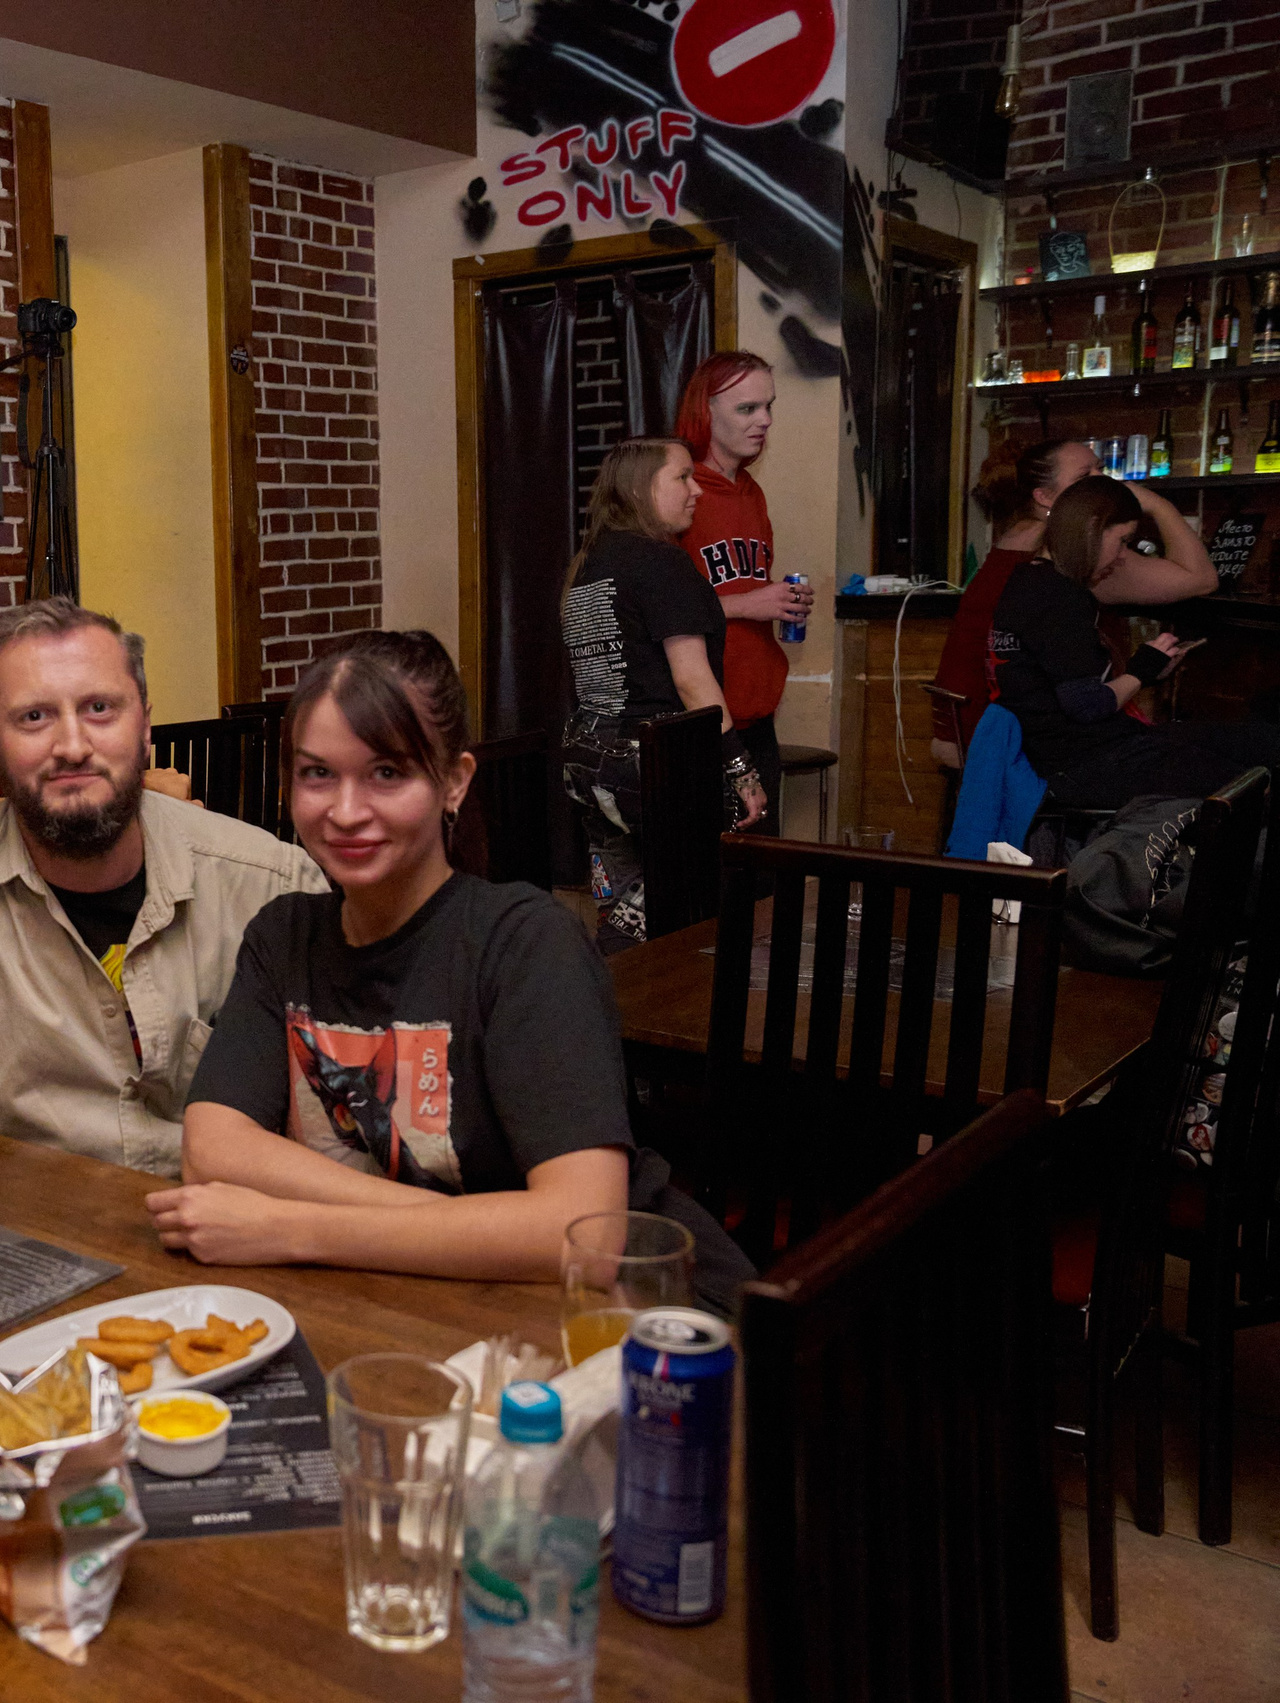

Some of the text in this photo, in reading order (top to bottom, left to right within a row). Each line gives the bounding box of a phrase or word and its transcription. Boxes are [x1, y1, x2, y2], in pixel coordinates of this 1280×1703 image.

[500, 108, 697, 188] STUFF
[516, 160, 687, 228] ONLY
[417, 1047, 439, 1116] らめん
